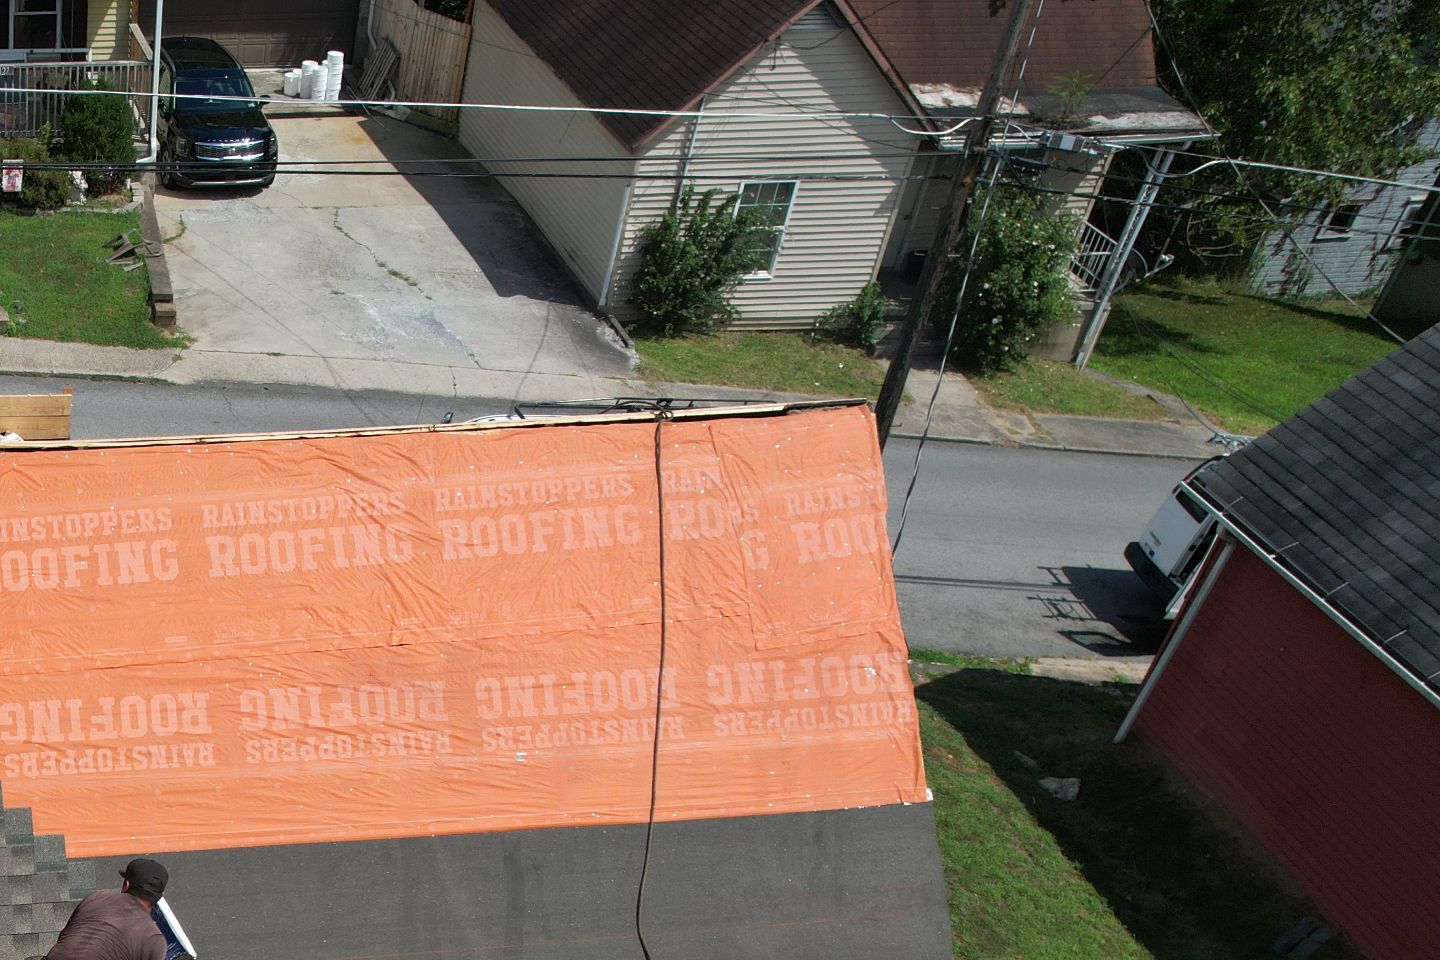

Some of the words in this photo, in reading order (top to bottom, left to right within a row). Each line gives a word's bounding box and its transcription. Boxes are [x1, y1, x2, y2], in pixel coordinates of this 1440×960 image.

[201, 491, 407, 528] RAINSTOPPERS
[432, 474, 634, 512] RAINSTOPPERS
[205, 522, 412, 578] ROOFING
[436, 504, 641, 561] ROOFING
[475, 667, 680, 720] ROOFING
[707, 652, 910, 705] ROOFING
[0, 692, 213, 745] ROOFING
[240, 680, 448, 731] ROOFING
[713, 702, 914, 737] RAINSTOPPERS
[4, 743, 216, 778] RAINSTOPPERS
[245, 730, 453, 764] RAINSTOPPERS
